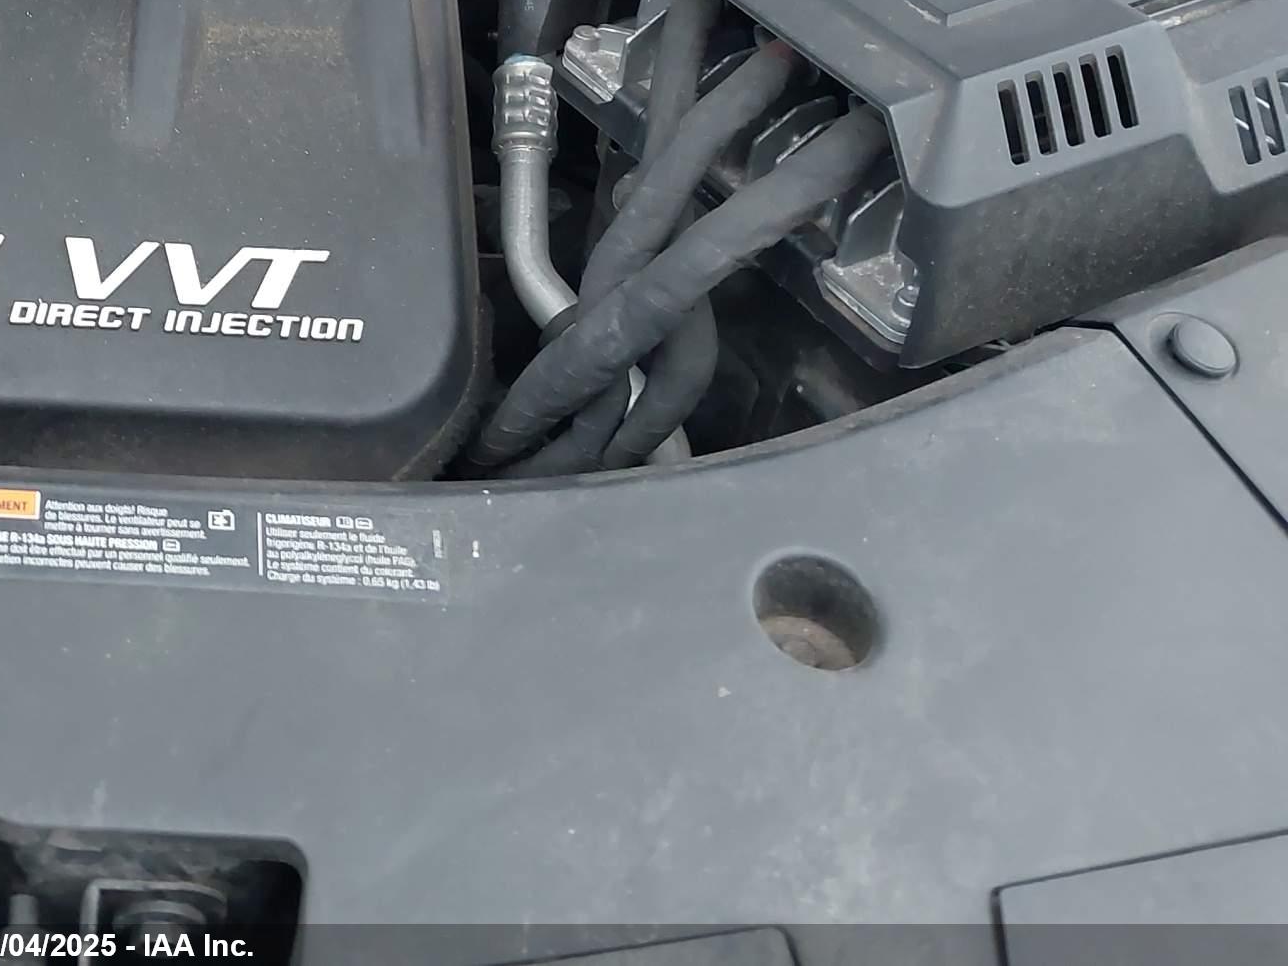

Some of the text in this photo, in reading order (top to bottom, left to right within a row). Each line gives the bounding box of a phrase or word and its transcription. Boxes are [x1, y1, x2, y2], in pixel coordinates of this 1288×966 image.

[65, 237, 330, 309] VVT
[9, 299, 364, 341] DIRECT INJECTION
[45, 500, 168, 517] Attention aux doigts! Risque
[266, 514, 331, 527] CLIMATISEUR
[10, 532, 45, 544] R-134a
[47, 534, 73, 546] SOUS
[74, 535, 107, 548] HAUTE
[108, 537, 157, 550] PRESSION
